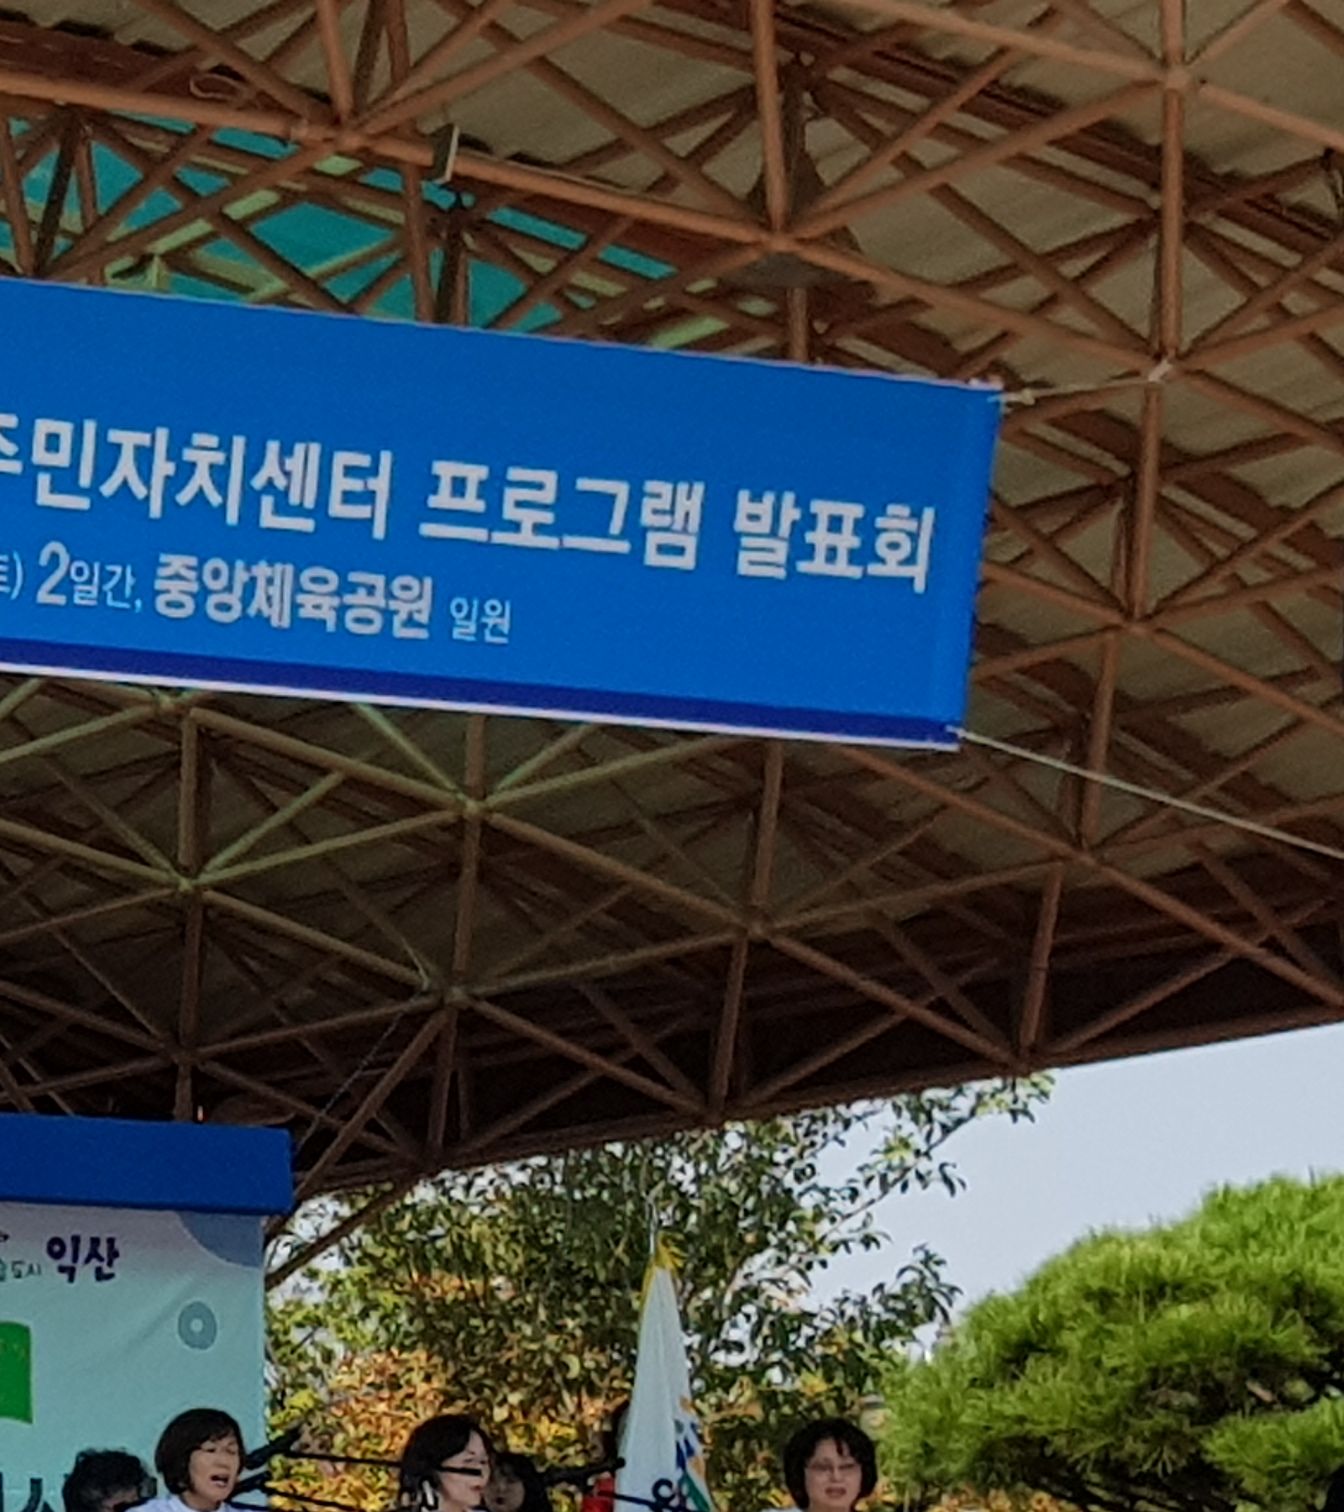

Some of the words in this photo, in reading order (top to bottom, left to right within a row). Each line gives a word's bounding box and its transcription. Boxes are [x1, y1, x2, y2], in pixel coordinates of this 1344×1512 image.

[419, 459, 706, 571] 프로그램
[733, 489, 936, 595] 발표회
[36, 541, 143, 614] 2일간,
[154, 552, 433, 640] 중앙체육공원
[449, 598, 512, 645] 일원
[46, 1234, 120, 1283] 익산
